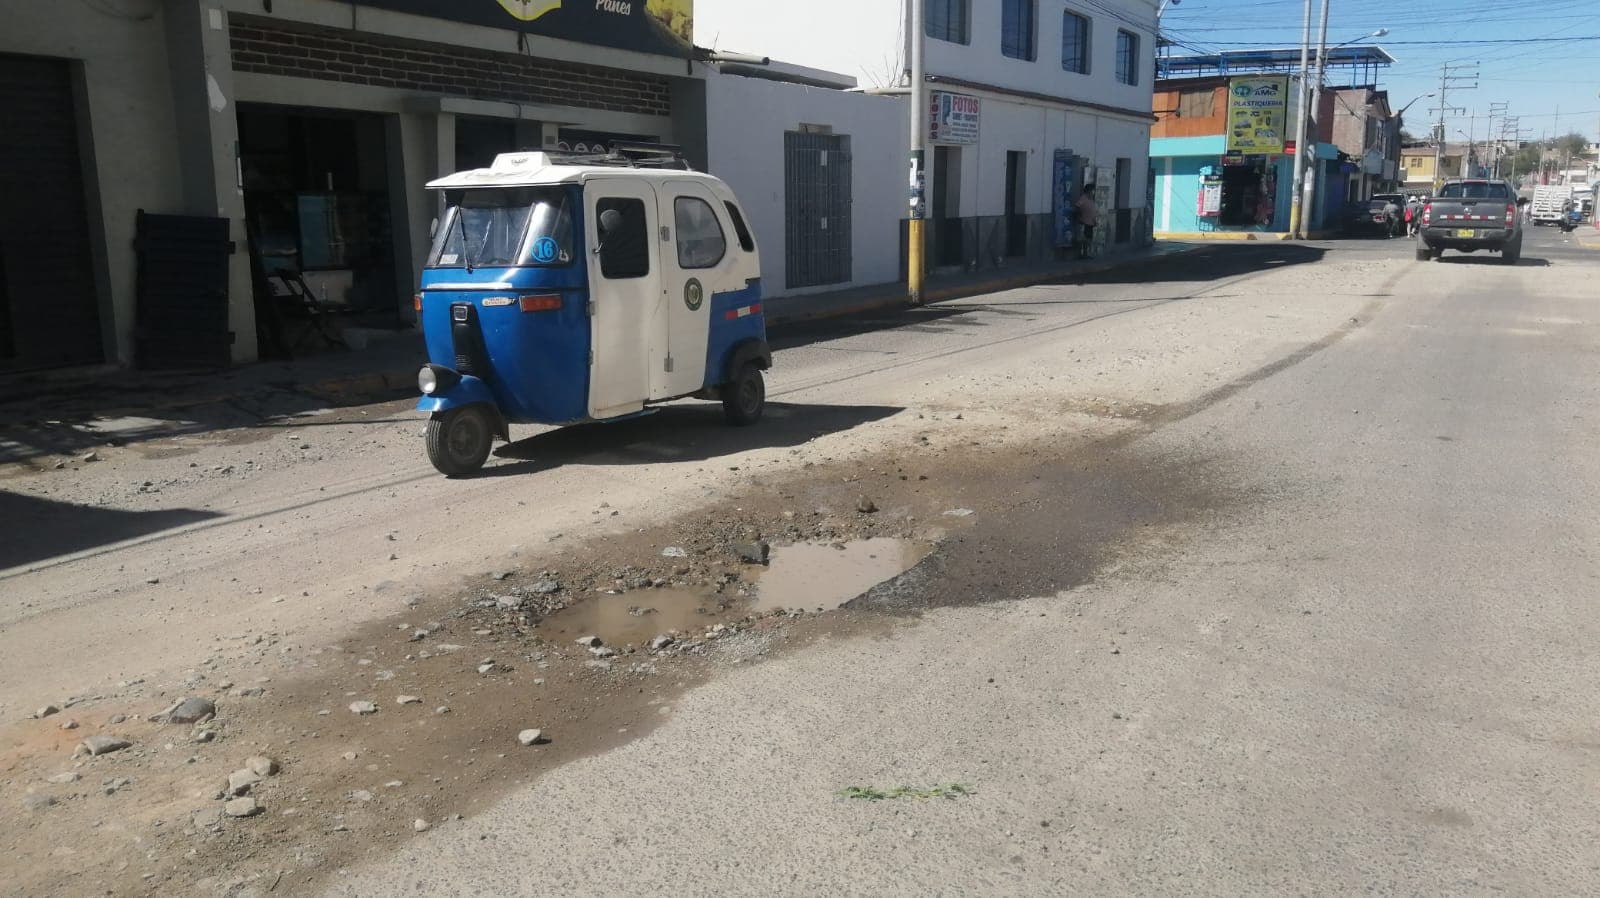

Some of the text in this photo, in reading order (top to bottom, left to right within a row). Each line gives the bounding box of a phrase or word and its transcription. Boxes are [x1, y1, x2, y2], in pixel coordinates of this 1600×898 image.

[595, 0, 631, 15] Panes
[952, 96, 979, 113] FOTOS
[536, 240, 554, 259] 16
